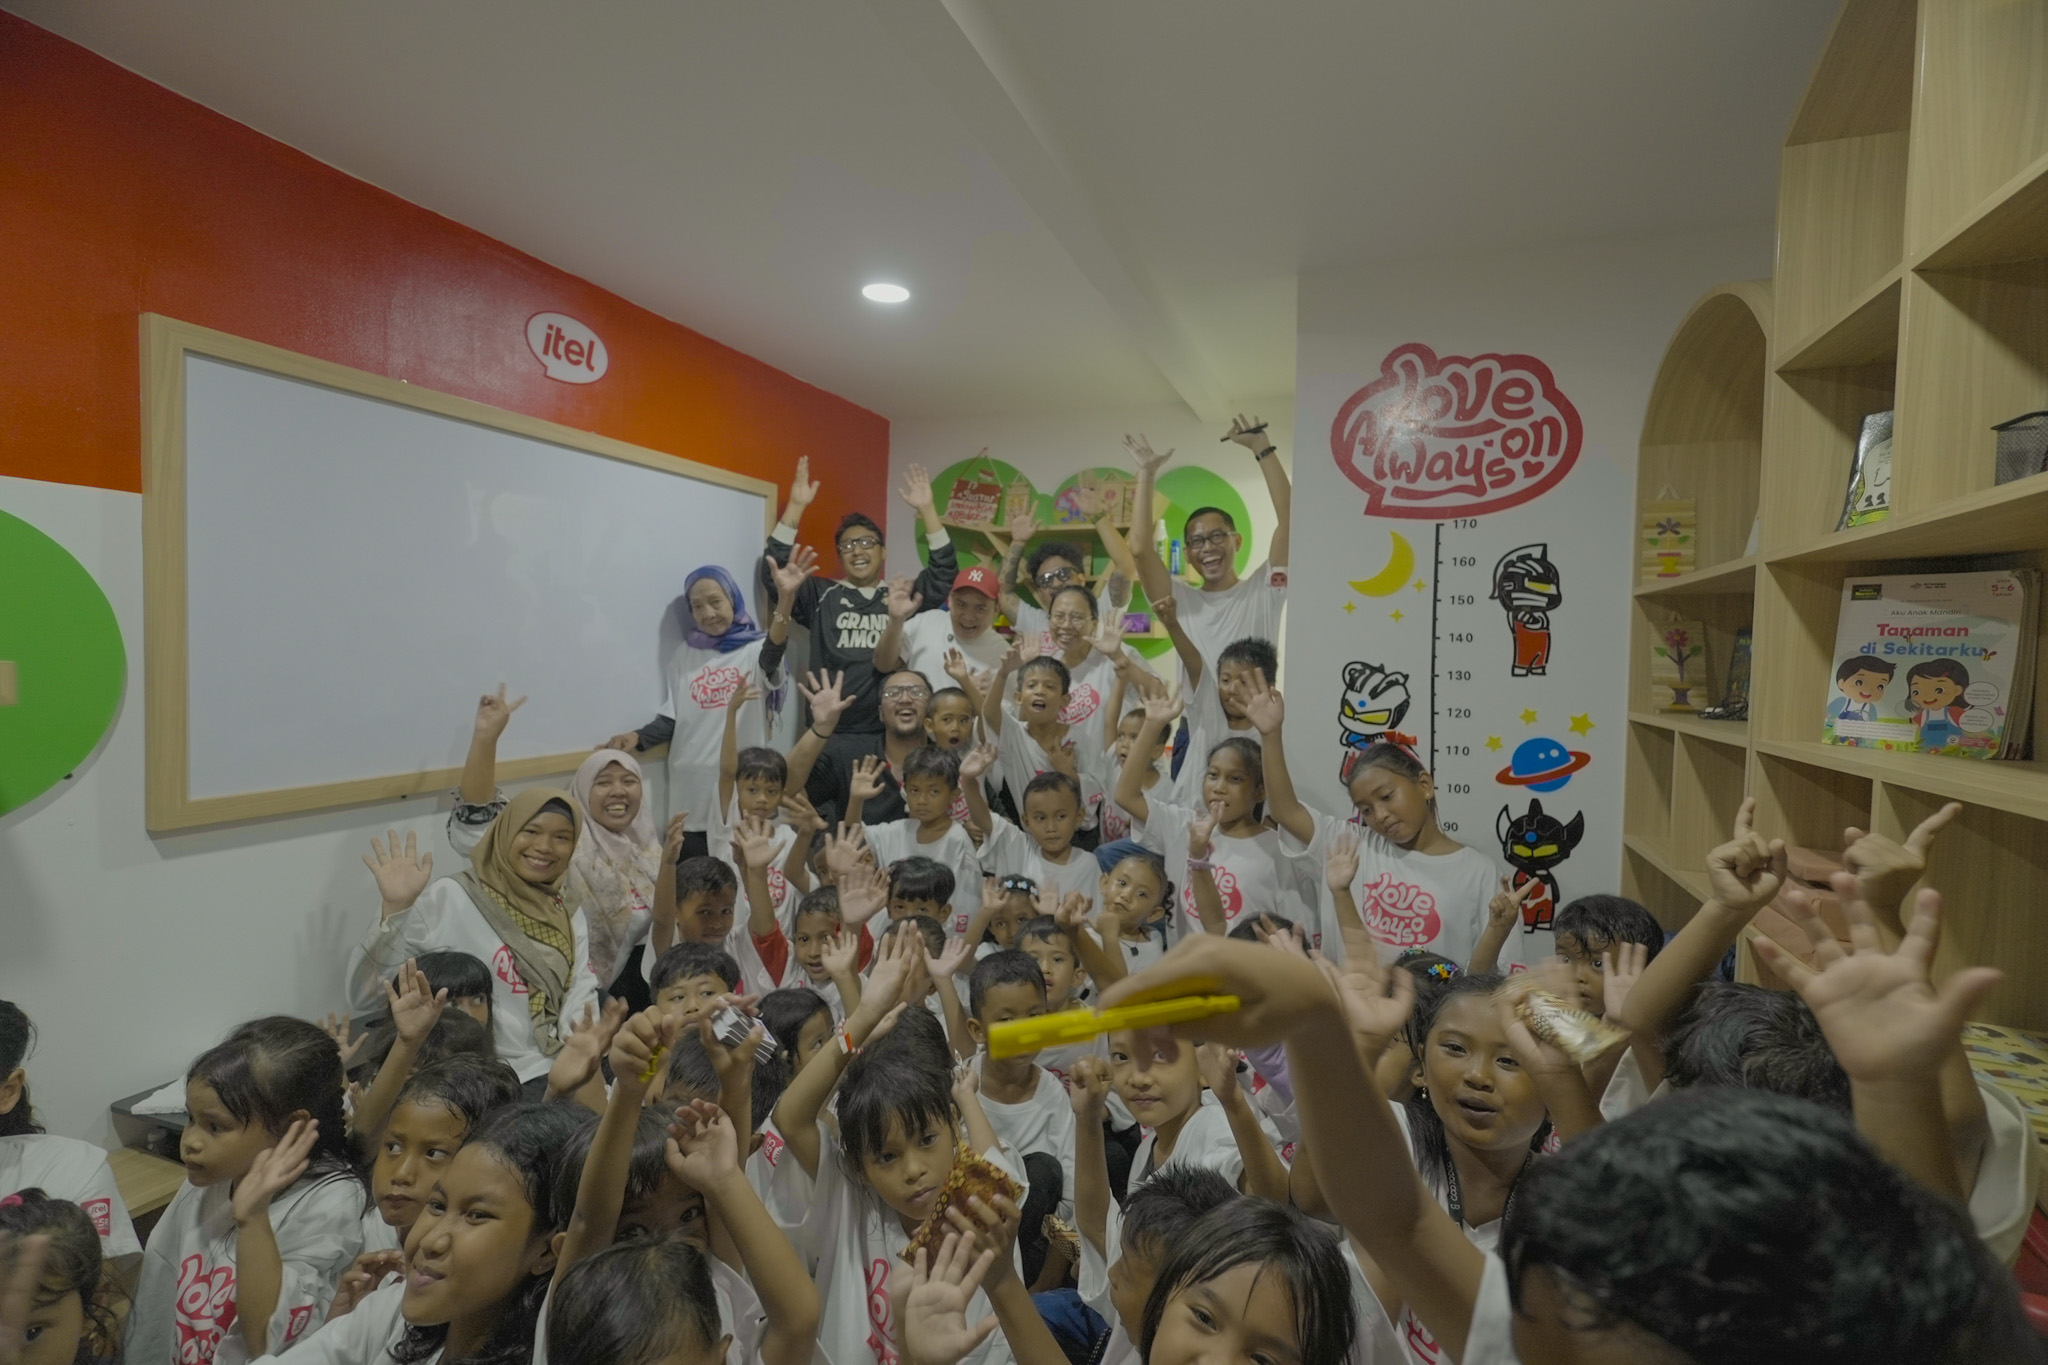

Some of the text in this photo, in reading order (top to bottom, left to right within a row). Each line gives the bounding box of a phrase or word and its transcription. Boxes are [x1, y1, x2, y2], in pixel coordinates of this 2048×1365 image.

[543, 323, 595, 373] itel
[1381, 359, 1534, 438] Love
[1501, 416, 1562, 460] on
[1452, 518, 1478, 529] 170
[1452, 556, 1476, 567] 160
[1450, 595, 1475, 605] 150
[1929, 608, 1962, 616] Mandiri
[1877, 623, 1970, 637] Tanaman
[836, 629, 883, 649] AMO
[1449, 632, 1474, 643] 140
[1860, 642, 1985, 657] di Sekitarku
[1447, 670, 1472, 681] 130
[1447, 707, 1472, 719] 120
[1446, 745, 1470, 757] 110
[1447, 783, 1471, 794] 100
[1443, 821, 1459, 832] 90
[1371, 873, 1432, 918] Love
